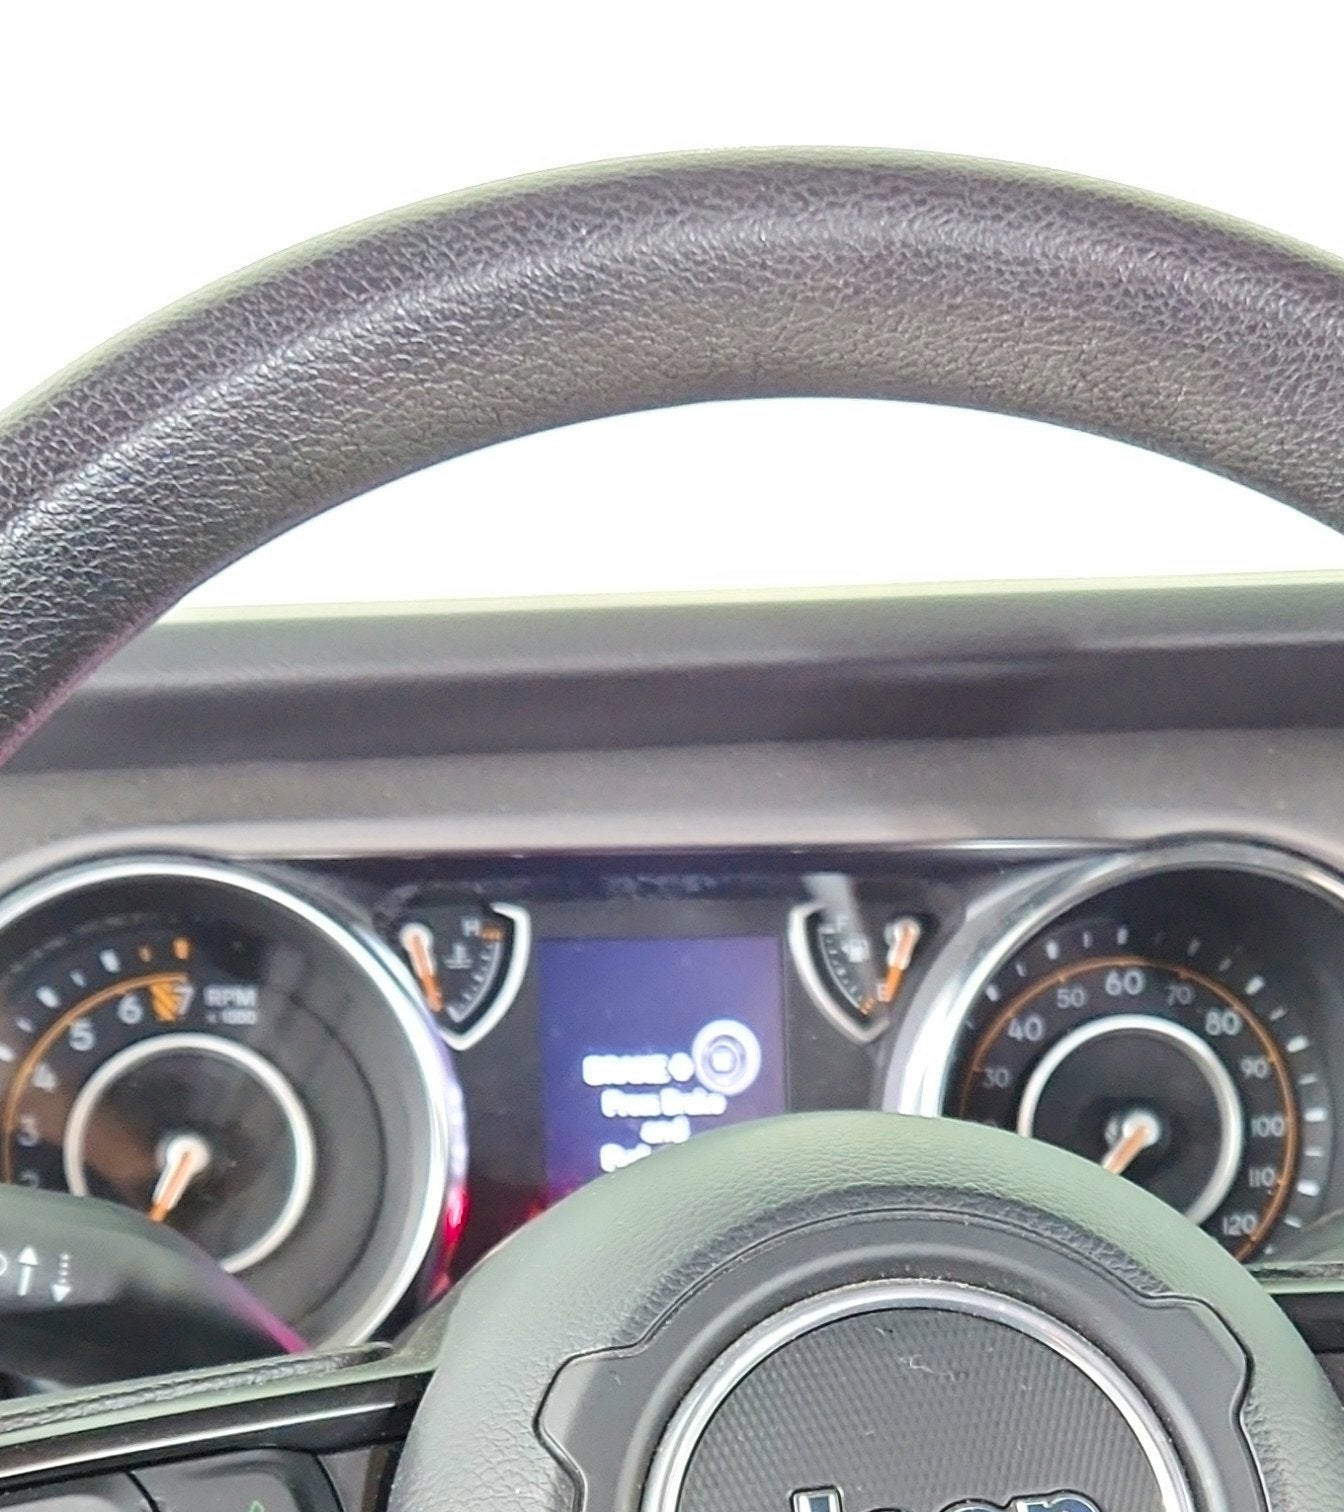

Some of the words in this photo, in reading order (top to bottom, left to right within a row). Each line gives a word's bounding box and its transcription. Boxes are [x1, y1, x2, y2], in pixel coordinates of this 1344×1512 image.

[1104, 970, 1145, 997] 60
[1165, 984, 1195, 1006] 70
[203, 985, 256, 1007] RPM
[1056, 987, 1086, 1010] 50
[119, 995, 144, 1025] 6
[68, 1017, 96, 1051] 5
[1007, 1010, 1045, 1042] 40
[1204, 1009, 1242, 1037] 80
[31, 1060, 59, 1092] 4
[982, 1067, 1013, 1090] 30
[1240, 1058, 1270, 1080] 90
[16, 1113, 41, 1148] 3
[1250, 1116, 1288, 1138] 100
[1248, 1166, 1278, 1188] 110
[1221, 1213, 1257, 1237] 120
